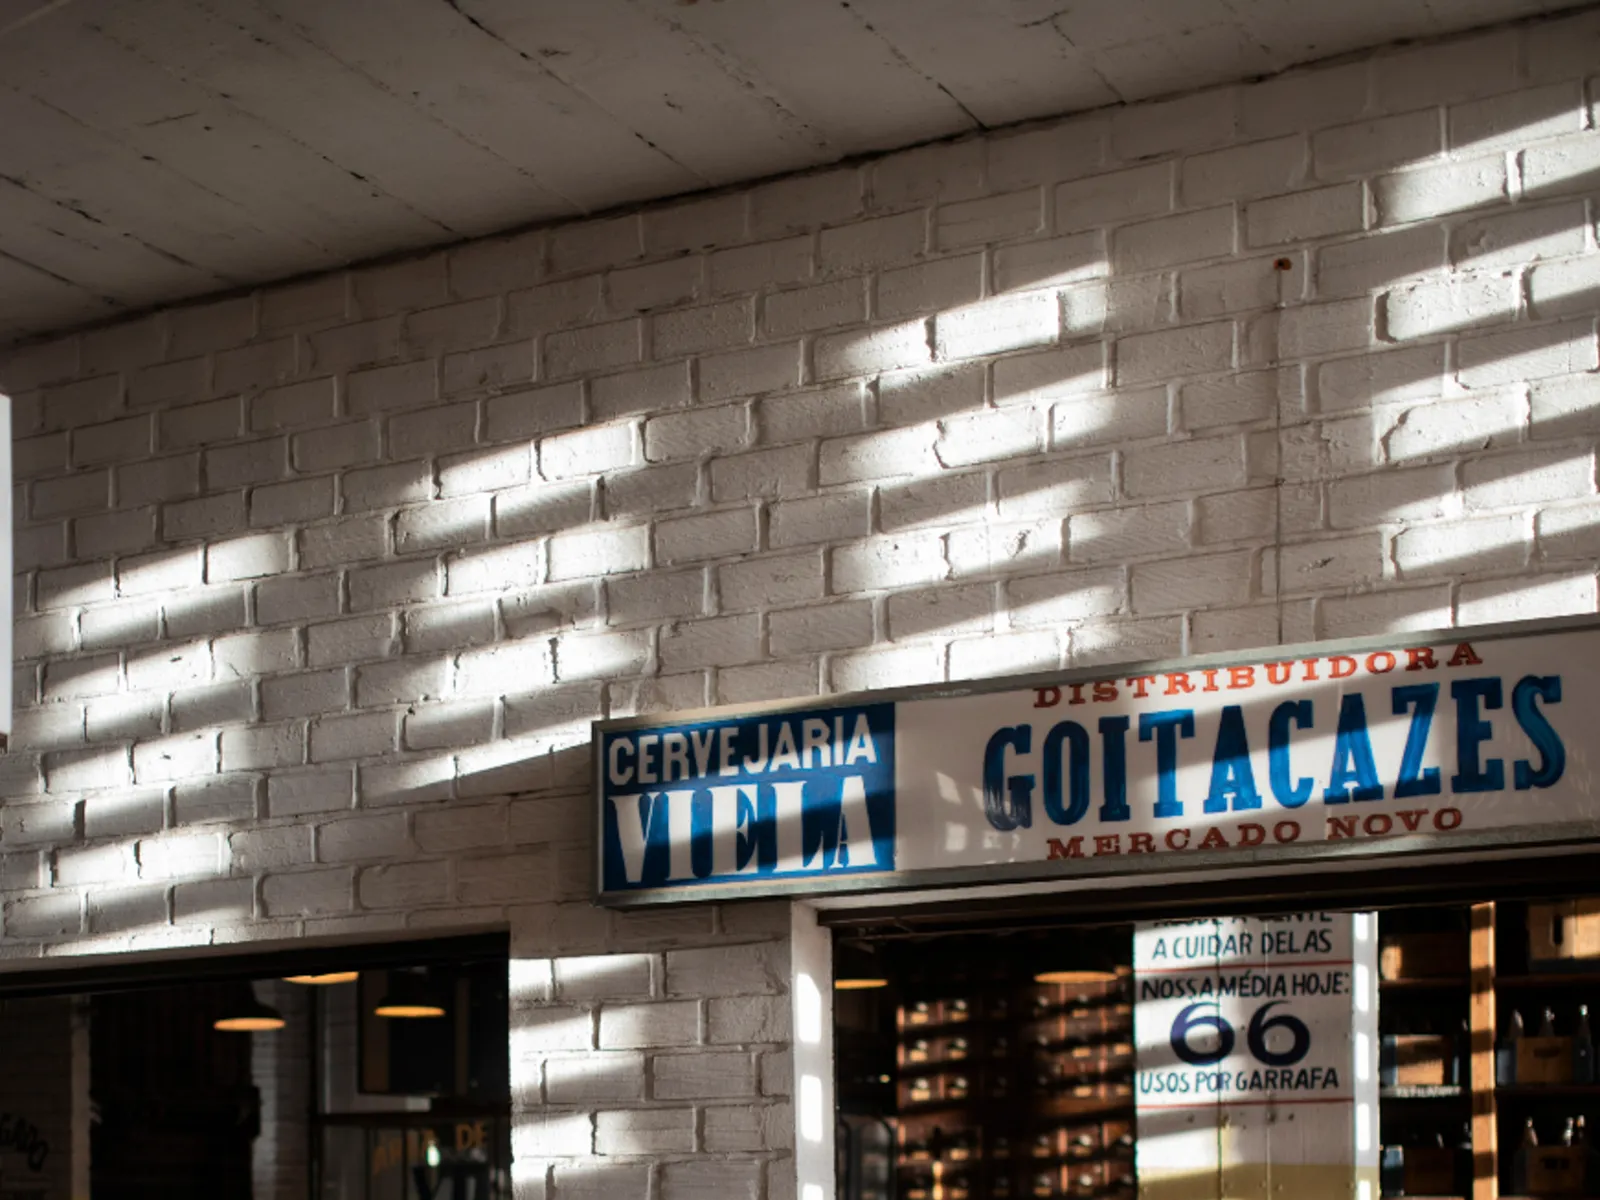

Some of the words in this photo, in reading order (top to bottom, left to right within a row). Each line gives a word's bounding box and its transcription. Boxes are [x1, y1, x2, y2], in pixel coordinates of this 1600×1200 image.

[1033, 642, 1483, 708] DISTRIBUIDORA
[609, 714, 877, 785] CERVEJARIA
[983, 674, 1566, 832] GOITACAZES
[609, 775, 877, 884] VIELA
[1046, 820, 1301, 860] MERCADO
[1326, 807, 1463, 840] NOVO
[1152, 938, 1168, 960] A
[1172, 935, 1253, 960] CUIDAR
[1261, 929, 1332, 955] DELAS
[1141, 976, 1214, 1000] NOSSA
[1218, 971, 1287, 998] MÉDIA
[1292, 972, 1349, 996] HOJE:
[1170, 1000, 1310, 1066] 66
[1140, 1071, 1190, 1094] USOS
[1195, 1070, 1231, 1093] POR
[1236, 1067, 1339, 1091] GARRAFA
